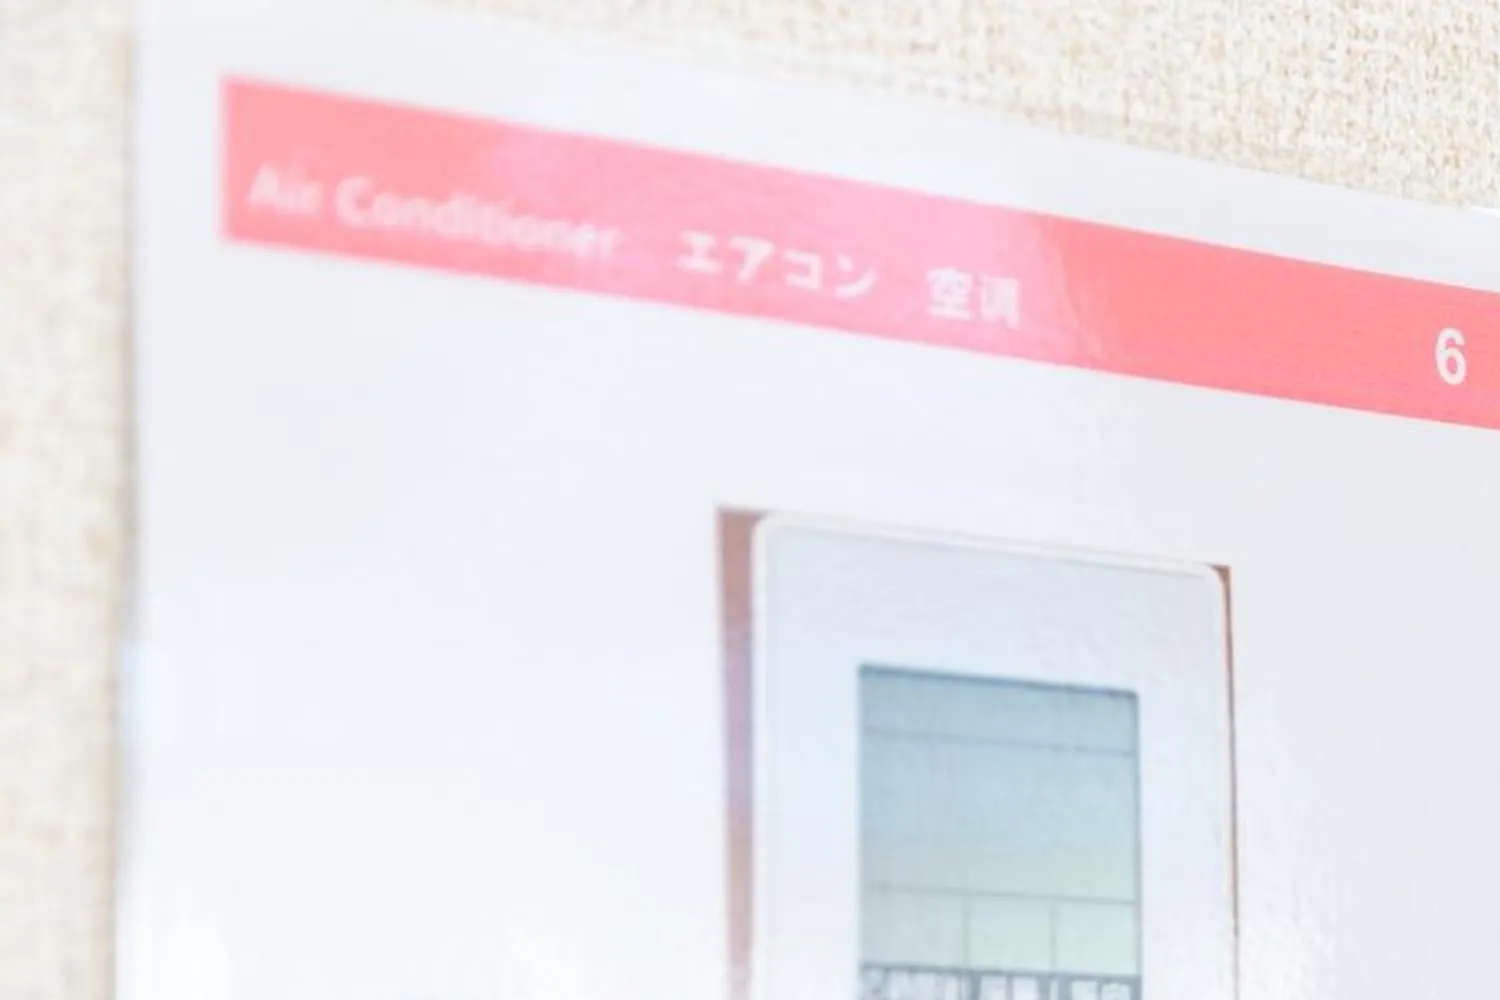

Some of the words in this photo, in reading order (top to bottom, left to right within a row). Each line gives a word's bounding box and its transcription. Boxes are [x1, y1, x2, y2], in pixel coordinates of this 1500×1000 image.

[246, 163, 318, 216] Air
[334, 174, 621, 262] Conditioner
[676, 230, 877, 299] エアコン
[1434, 327, 1467, 386] 6
